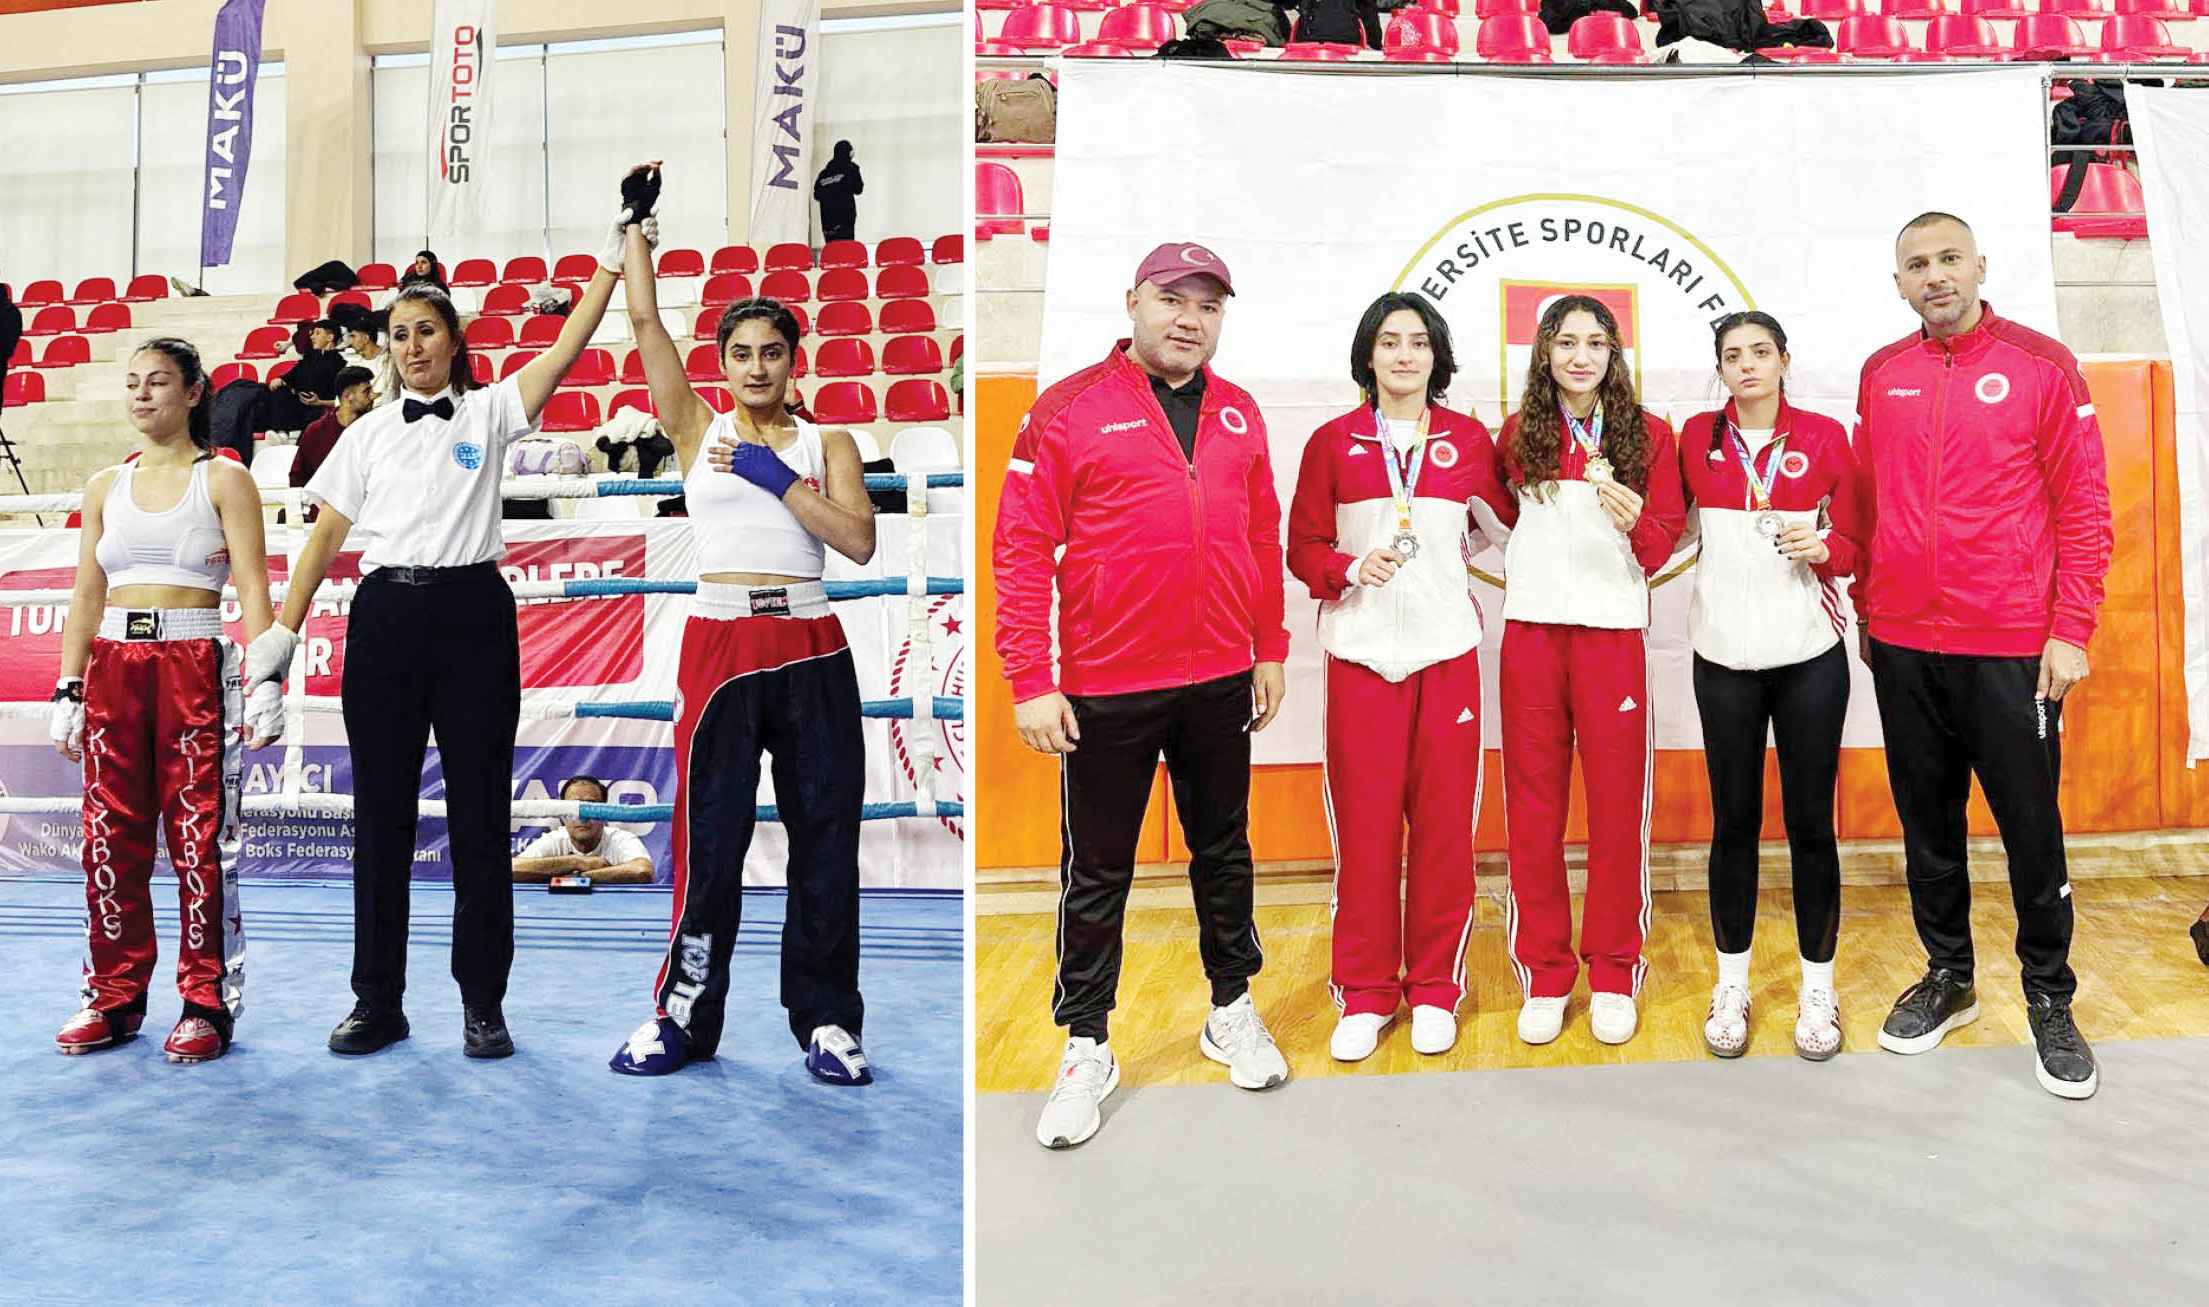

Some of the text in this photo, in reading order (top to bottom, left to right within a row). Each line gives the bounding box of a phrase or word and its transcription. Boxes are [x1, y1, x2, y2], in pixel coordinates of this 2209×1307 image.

[209, 50, 248, 210] MAKÜ
[767, 24, 806, 190] MAKÜ
[1420, 221, 1529, 301] ERSİTE
[1539, 217, 1704, 294] SPORLARI
[1101, 418, 1148, 435] uhlsport
[19, 842, 56, 857] Wako
[245, 842, 282, 858] Boks
[287, 842, 355, 860] Federasy
[241, 823, 335, 839] Federasyonu
